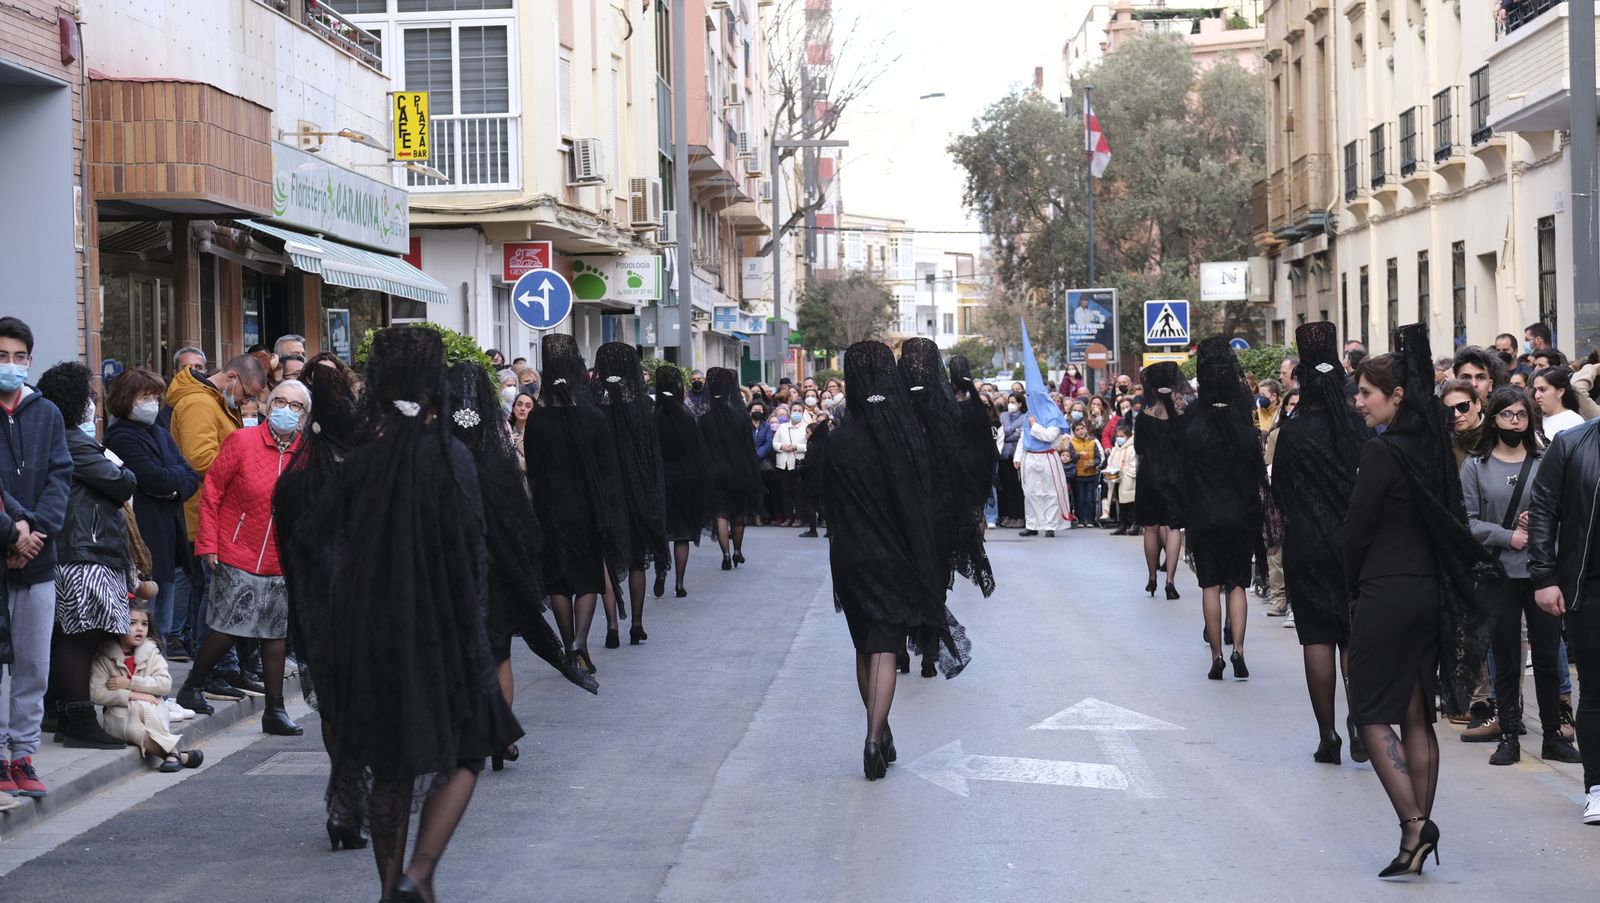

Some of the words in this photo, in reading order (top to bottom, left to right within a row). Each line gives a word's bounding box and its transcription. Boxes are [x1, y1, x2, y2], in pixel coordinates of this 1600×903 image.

[397, 95, 411, 148] CAFE
[413, 95, 426, 147] PLAZA
[413, 149, 427, 157] BAR
[336, 182, 380, 231] CARMONA
[1221, 267, 1238, 285] N
